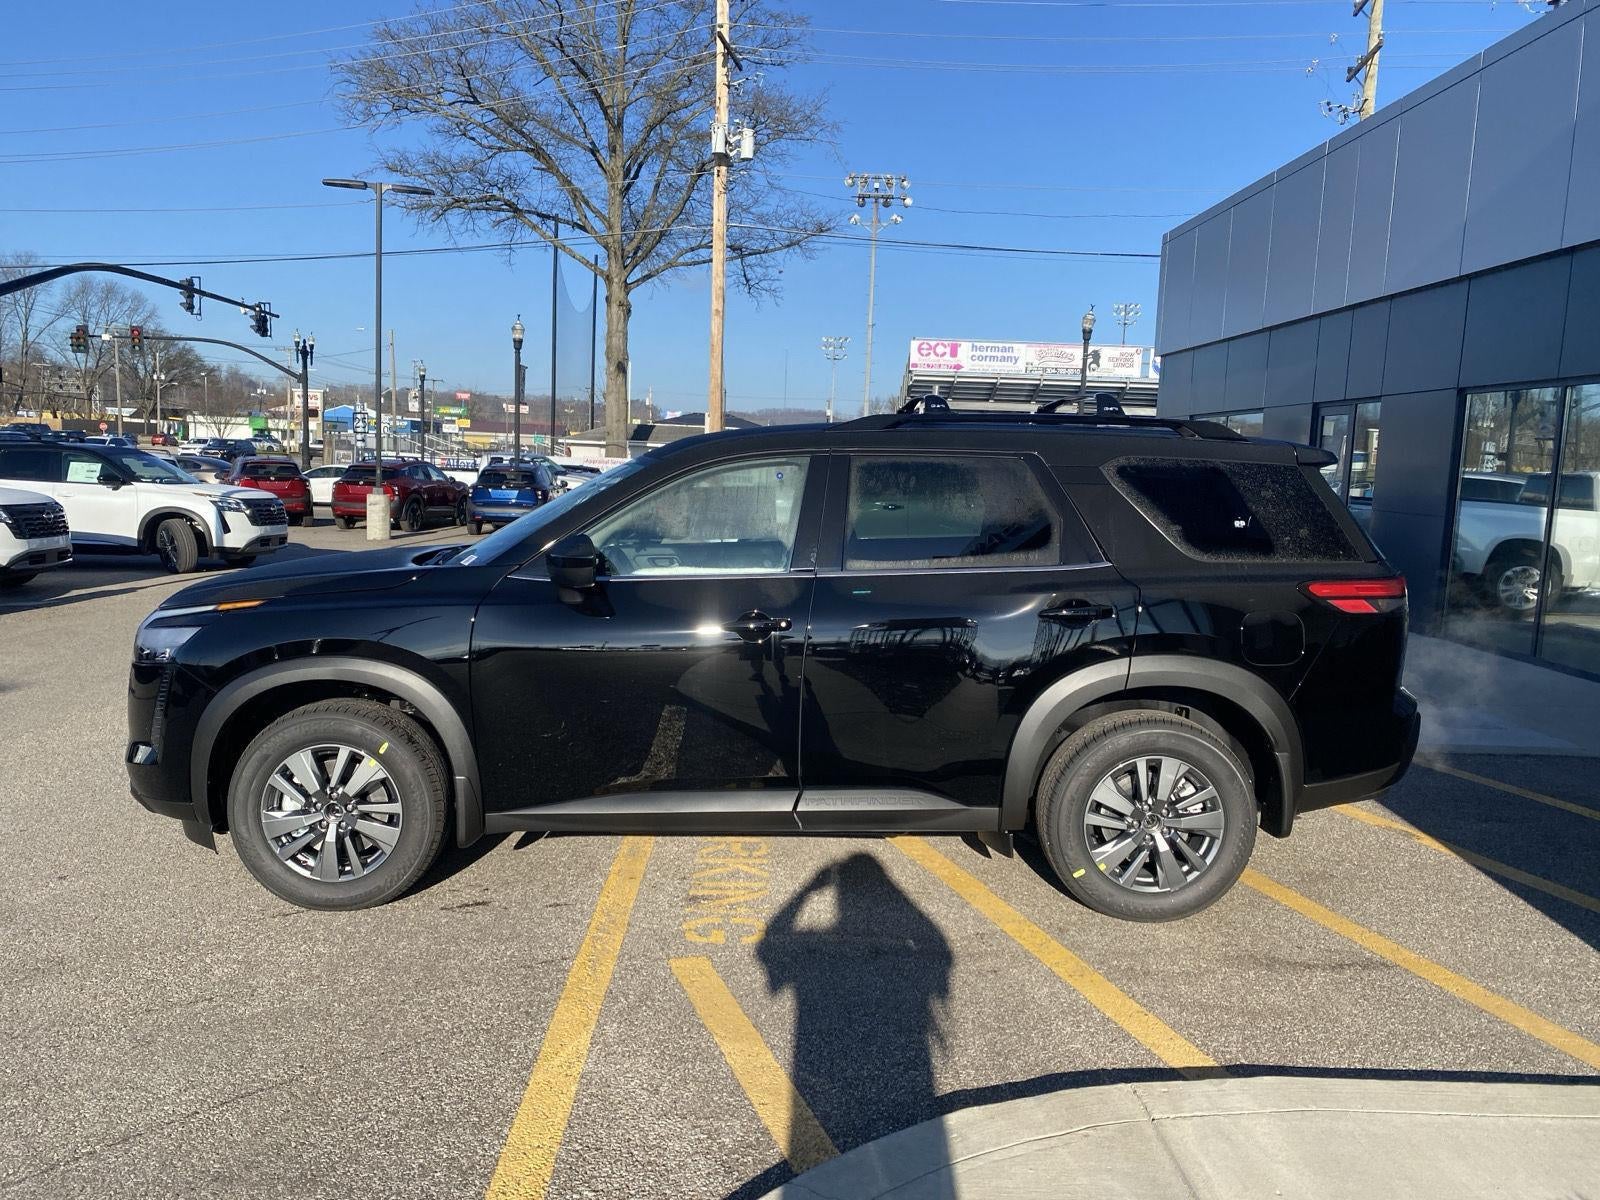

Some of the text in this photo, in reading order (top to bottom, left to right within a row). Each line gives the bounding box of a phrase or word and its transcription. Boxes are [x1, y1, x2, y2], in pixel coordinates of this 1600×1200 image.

[970, 343, 1014, 354] herman
[970, 353, 1020, 365] cormany
[354, 416, 367, 429] 25
[804, 796, 923, 807] PATHFINDER
